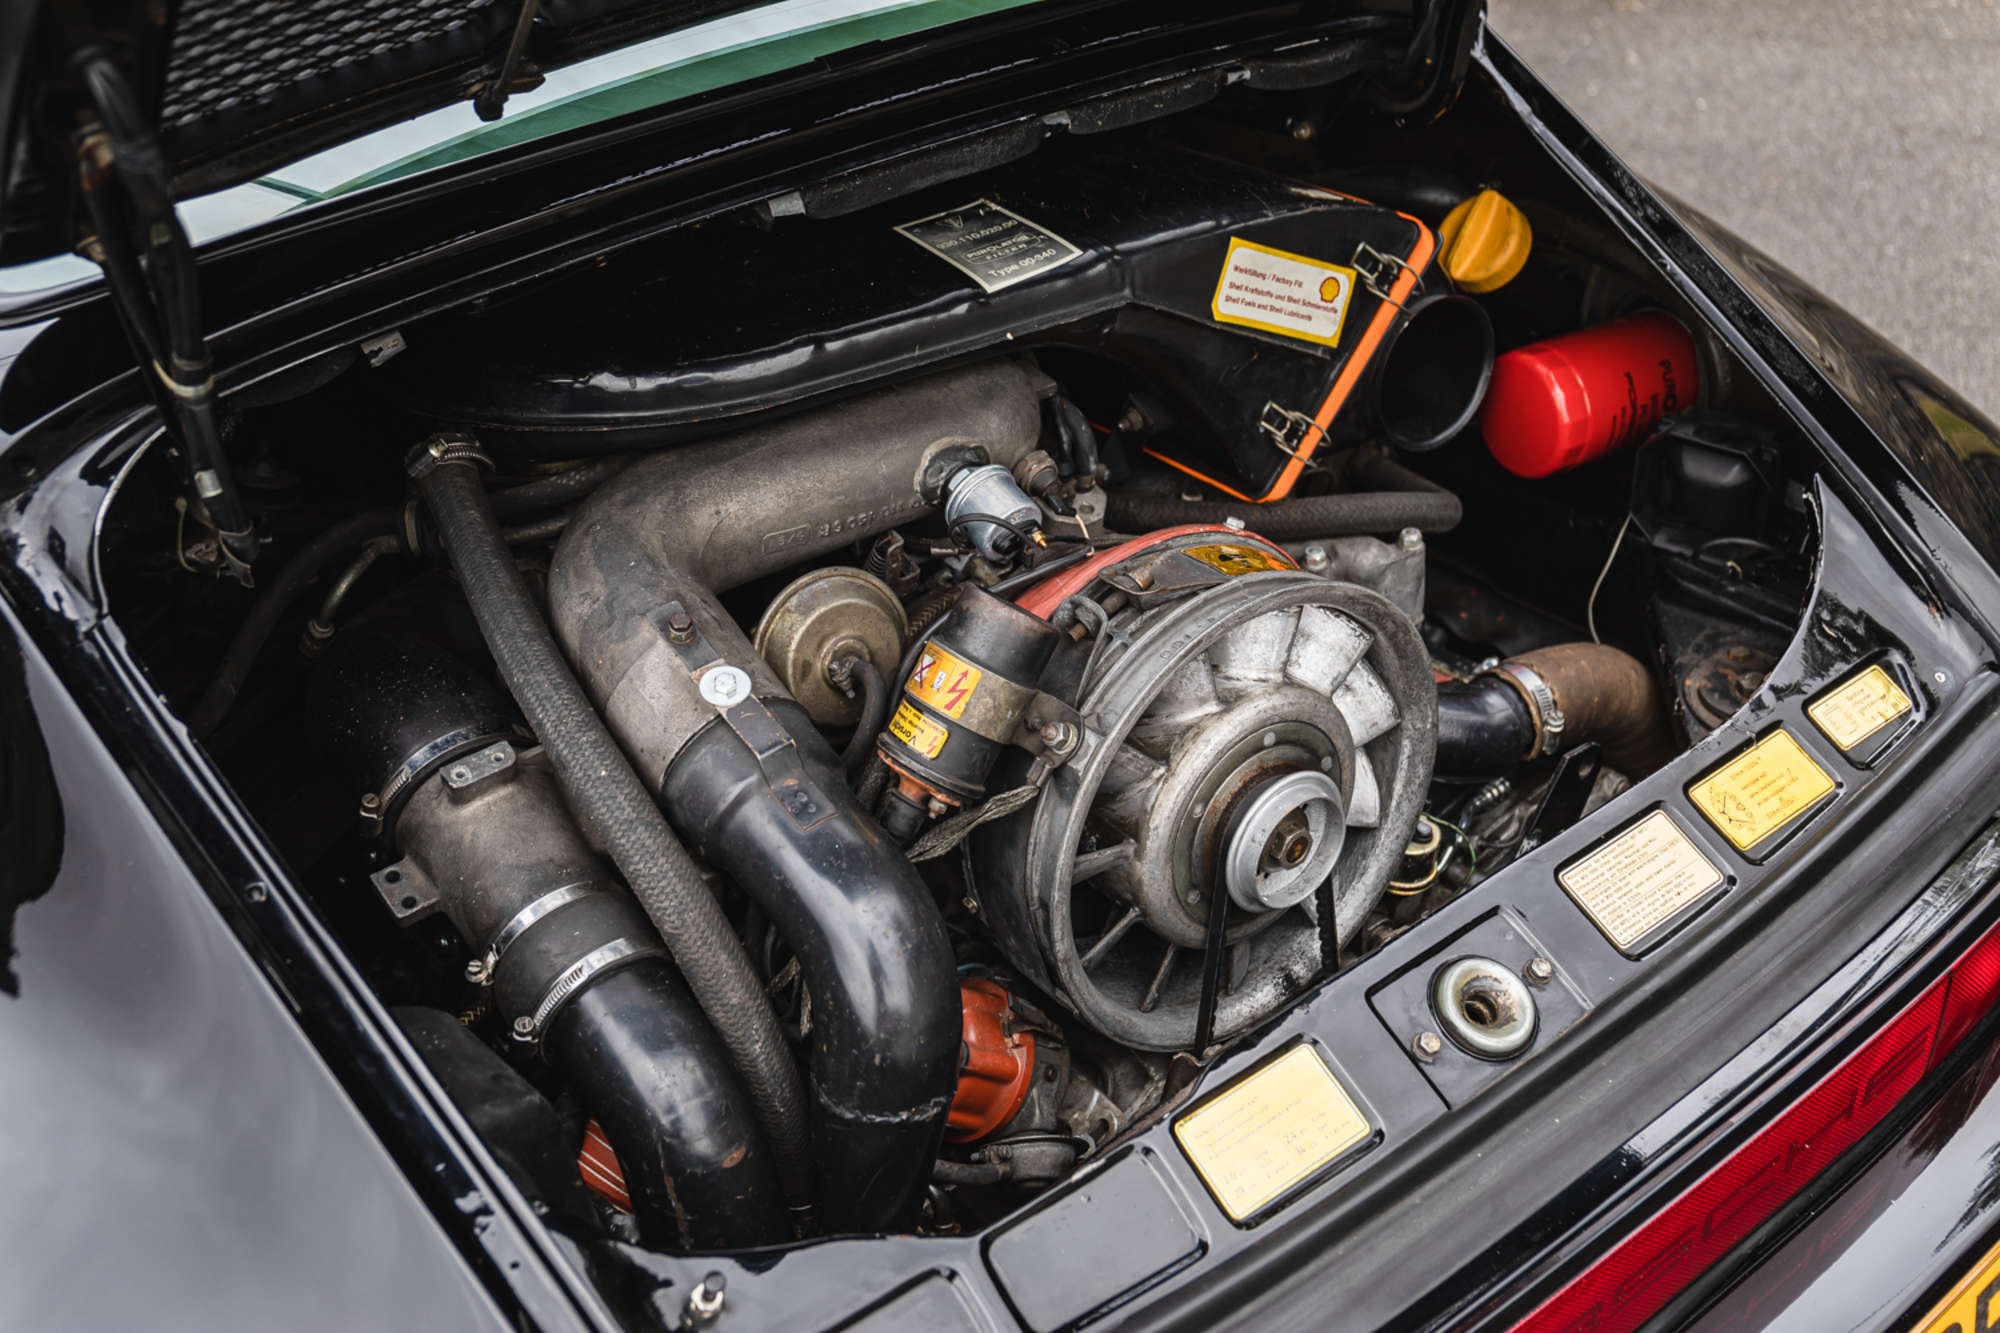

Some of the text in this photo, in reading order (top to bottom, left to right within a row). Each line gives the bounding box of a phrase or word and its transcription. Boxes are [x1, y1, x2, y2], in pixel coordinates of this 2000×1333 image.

[985, 244, 1027, 260] FILTER
[988, 264, 1019, 277] Type
[1271, 273, 1293, 287] Factory
[1294, 279, 1304, 288] Fill
[1228, 281, 1243, 290] Shell
[1287, 295, 1300, 304] Shell
[1224, 294, 1312, 322] Shell Fuels and Shell Lubricants
